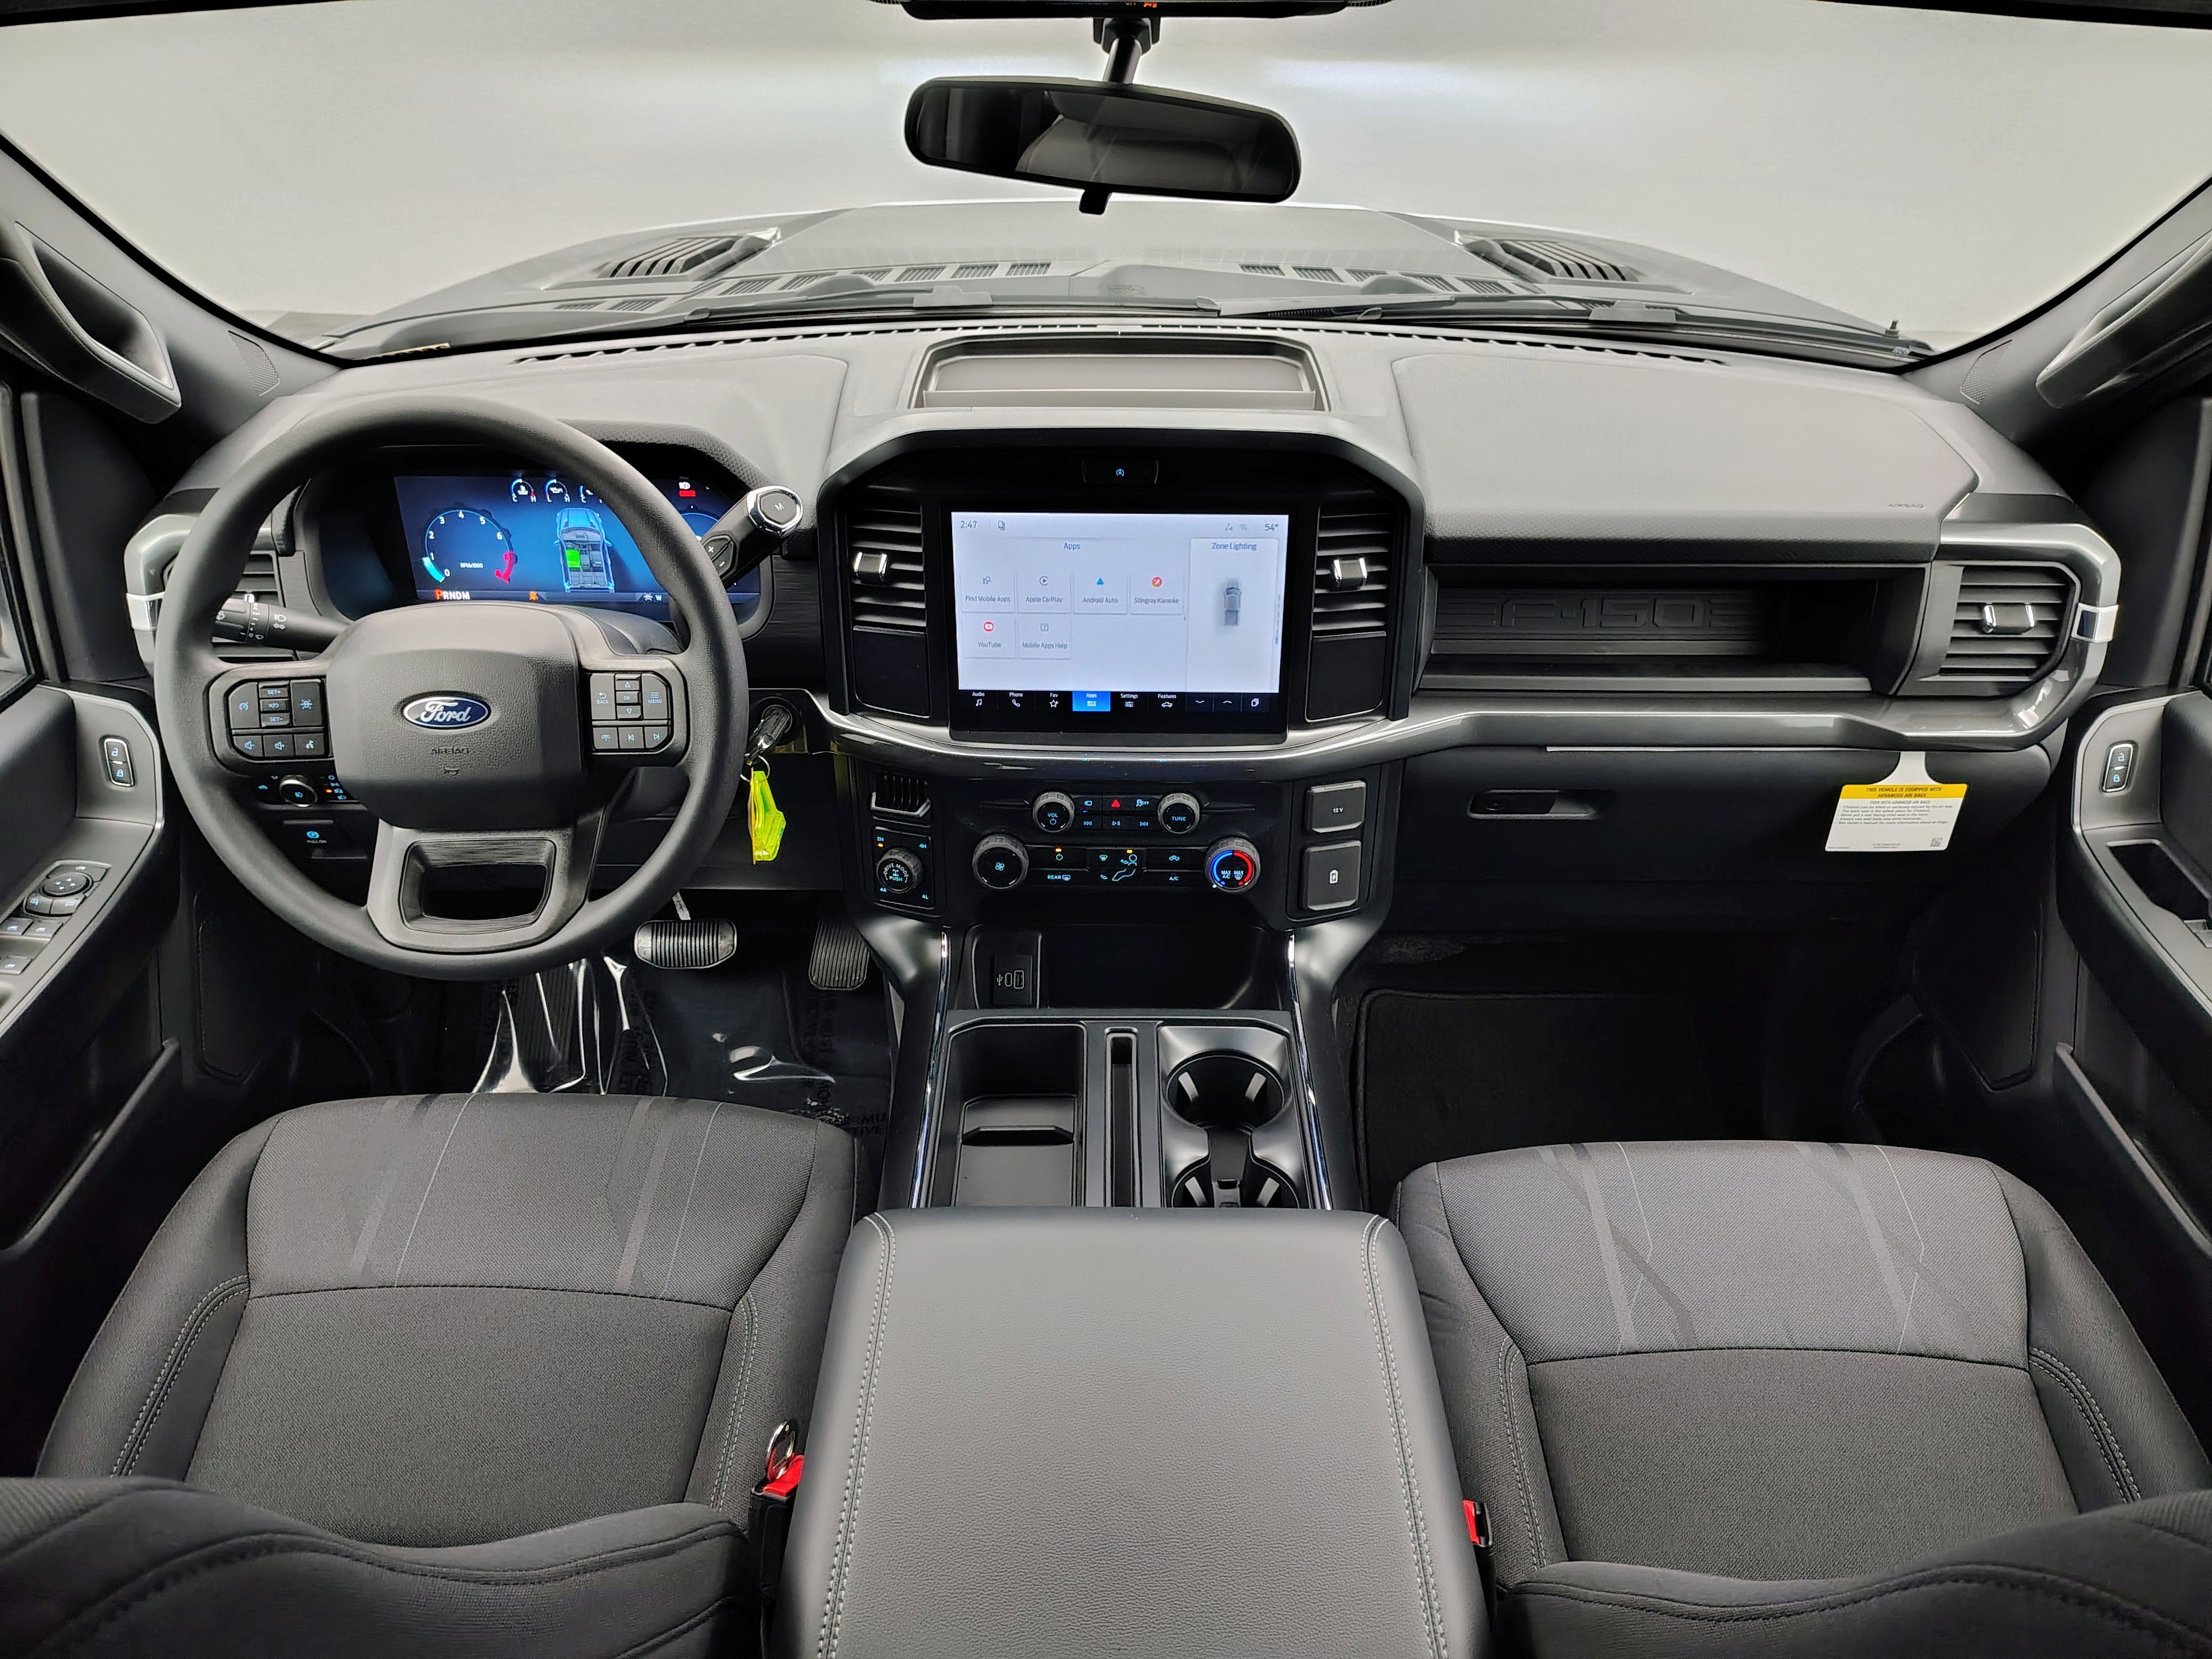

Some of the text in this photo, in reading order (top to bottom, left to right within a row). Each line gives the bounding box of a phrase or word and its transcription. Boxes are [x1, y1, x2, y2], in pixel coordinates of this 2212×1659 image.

[774, 502, 784, 511] M
[459, 510, 464, 518] 4
[439, 516, 445, 524] 3
[480, 516, 485, 525] 5
[960, 520, 977, 529] 2:47
[429, 531, 435, 539] 2
[497, 532, 503, 540] 6
[1063, 542, 1081, 551] Apps
[1230, 542, 1257, 551] Lighting
[430, 552, 434, 561] 1
[444, 569, 450, 577] 0
[1500, 598, 1703, 628] F-150
[420, 701, 471, 723] Ford
[883, 863, 909, 877] DRIVE MODE
